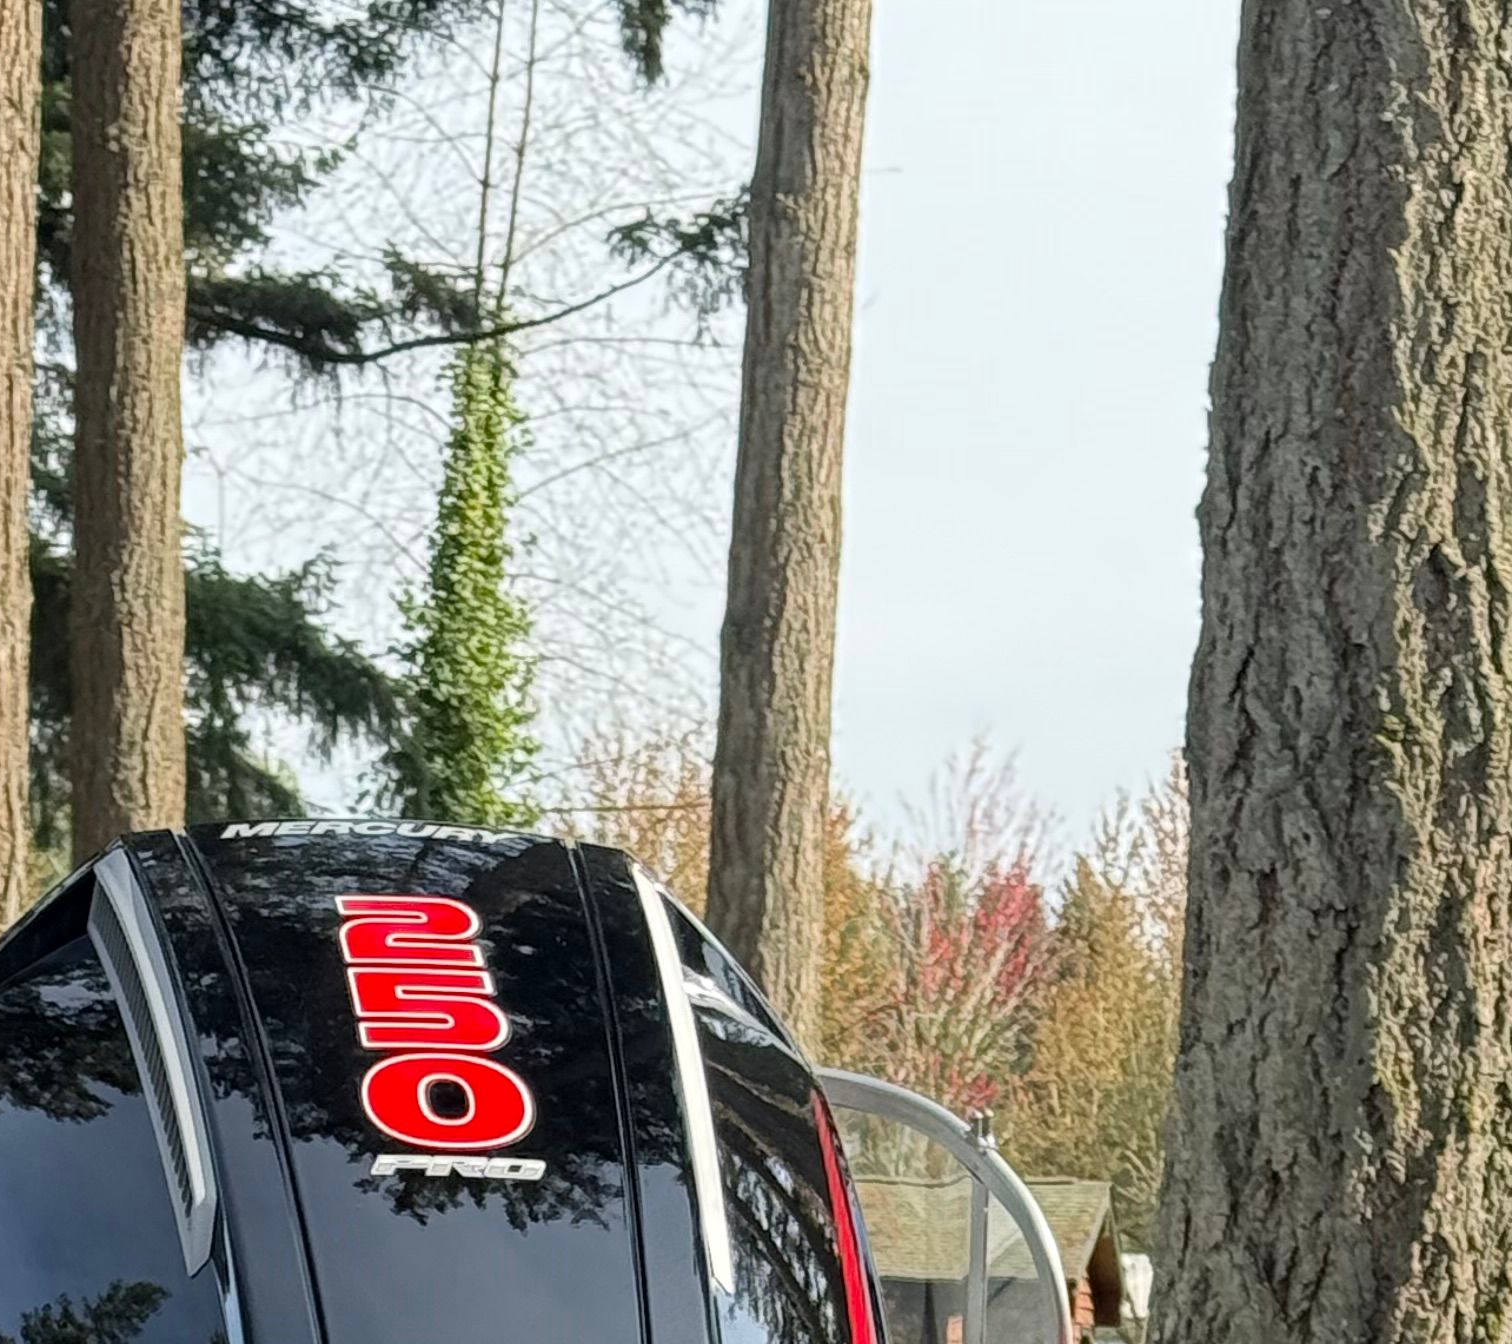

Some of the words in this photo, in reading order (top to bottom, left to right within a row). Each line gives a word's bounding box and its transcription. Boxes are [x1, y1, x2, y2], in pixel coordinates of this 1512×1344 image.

[220, 819, 518, 844] MERCURY
[334, 894, 536, 1150] 250
[369, 1153, 546, 1181] PRO
